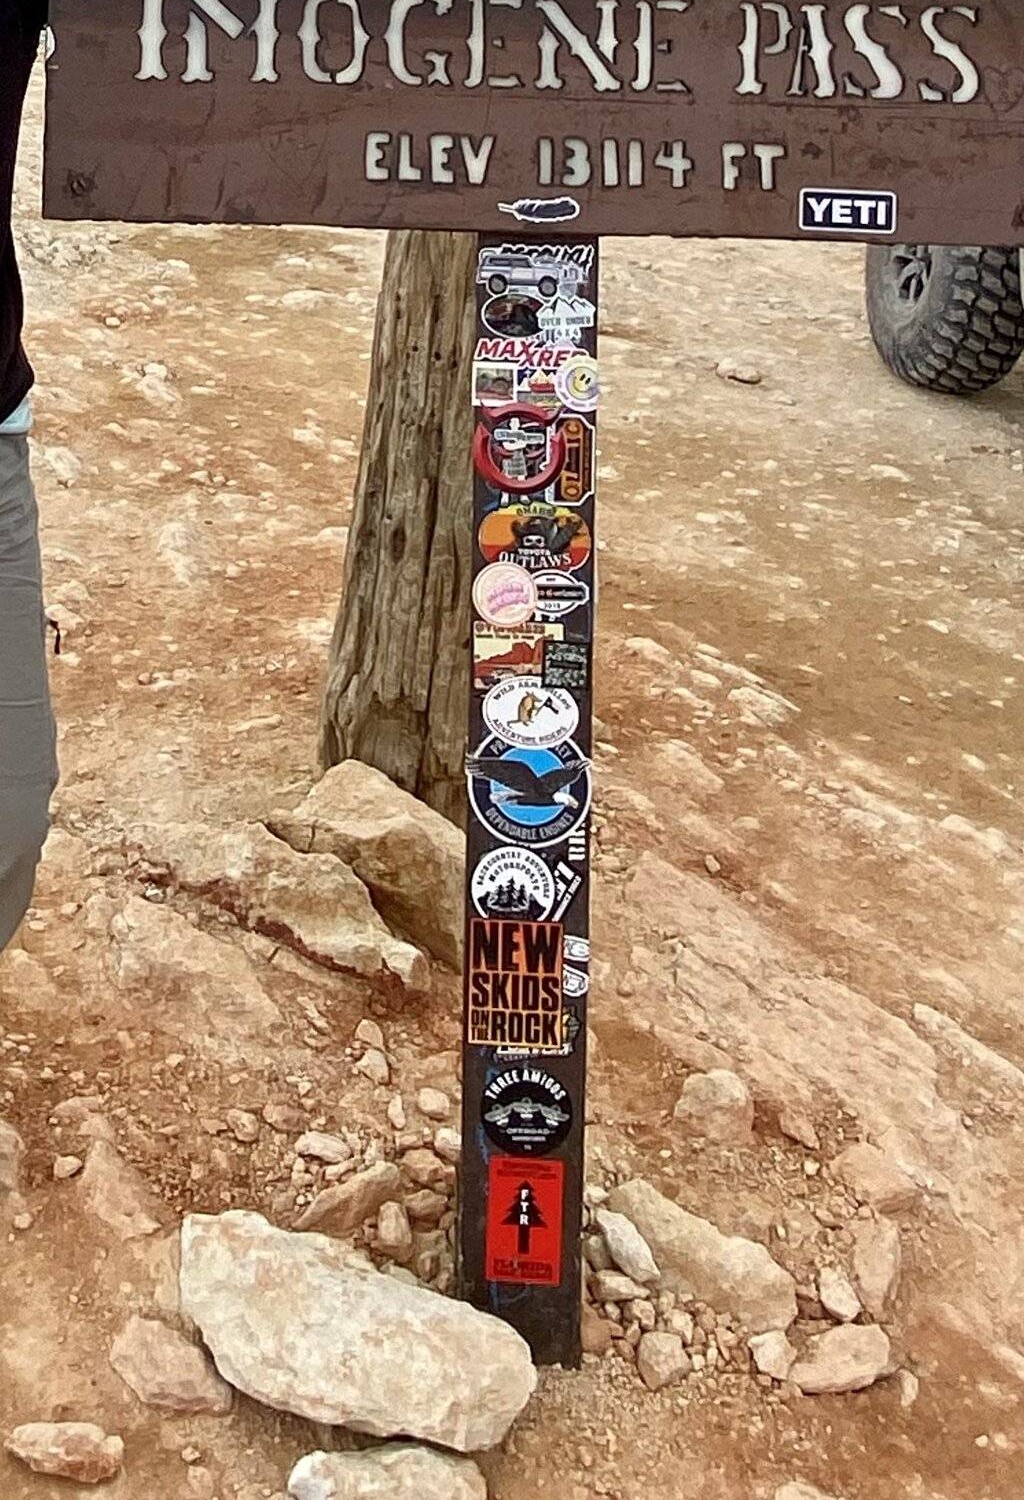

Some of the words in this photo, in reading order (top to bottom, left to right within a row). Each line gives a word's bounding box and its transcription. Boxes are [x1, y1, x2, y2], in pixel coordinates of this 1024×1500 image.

[735, 2, 980, 104] PASS
[362, 131, 495, 185] ELEV
[538, 137, 693, 188] 13114
[722, 143, 785, 191] FT
[806, 195, 887, 227] YETI
[499, 551, 572, 568] OUTLAWS
[472, 921, 561, 974] NEW
[472, 972, 560, 1012] SKIDS
[472, 1009, 489, 1026] ON
[491, 1011, 558, 1046] ROCK
[485, 1069, 520, 1100] THREE
[522, 1069, 567, 1101] AMIGOS
